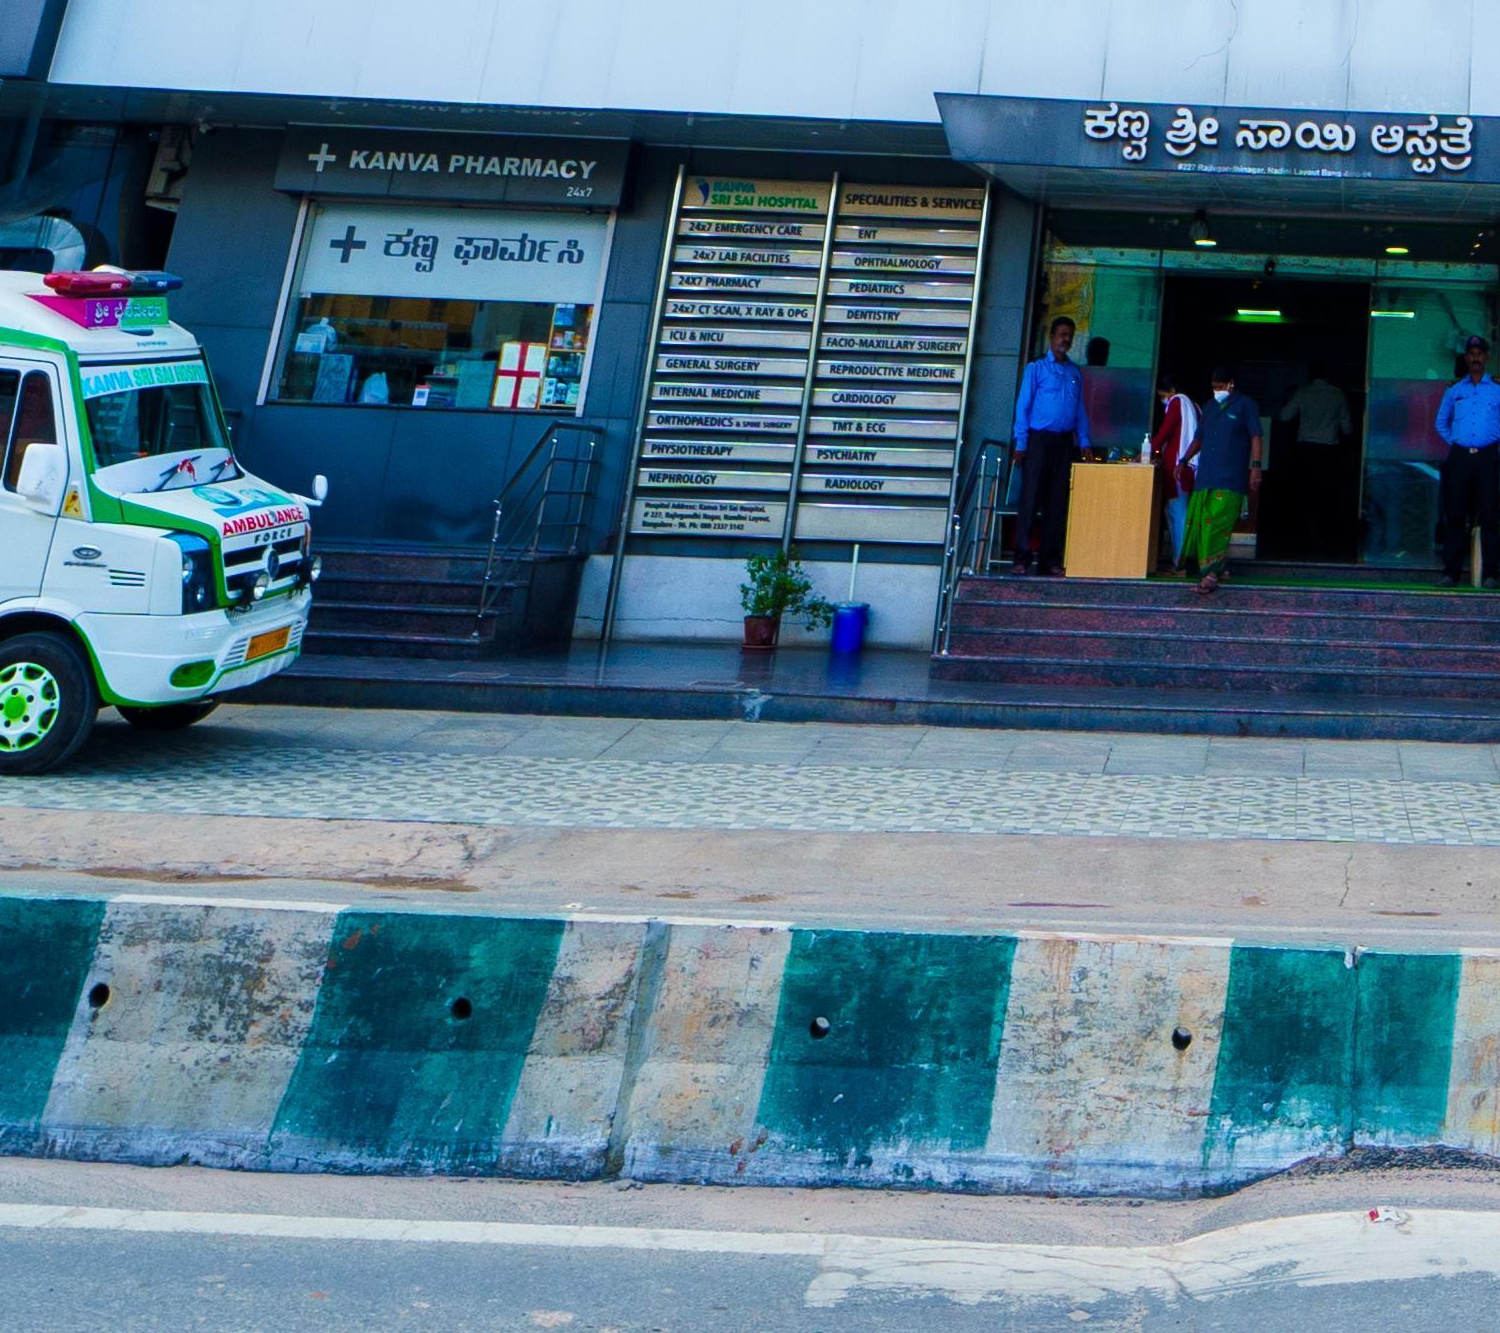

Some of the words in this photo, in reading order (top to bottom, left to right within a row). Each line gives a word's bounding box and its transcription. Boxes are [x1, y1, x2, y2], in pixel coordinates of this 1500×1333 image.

[1235, 117, 1356, 153] ಸಾಯಿ
[1370, 114, 1474, 174] ಆಸ್ಪತ್ರೆ
[349, 149, 440, 173] KANVA
[448, 154, 597, 180] PHARMACY
[566, 186, 593, 199] 24x7
[712, 181, 757, 194] KANVA
[711, 193, 731, 205] SRI
[733, 194, 754, 206] SAI
[757, 195, 819, 210] HOSPITAL
[845, 193, 918, 208] SPECIALITIES
[920, 196, 929, 207] &
[931, 197, 983, 210] SERVICES
[688, 221, 712, 232] 24x7
[714, 222, 775, 235] EMERGENCY
[776, 225, 803, 237] CARE
[857, 228, 878, 240] ENT
[692, 250, 717, 260] 24x7
[718, 251, 738, 262] LAB
[740, 252, 791, 263] FACILITIES
[854, 256, 941, 270] OPHTHALMOLOGY
[705, 277, 761, 289] PHARMACY
[848, 282, 905, 295] PEDIATRICS
[672, 303, 696, 314] 24x7
[698, 304, 713, 315] CT
[713, 305, 742, 317] SCAN,
[745, 307, 753, 316] X
[755, 307, 776, 317] RAY
[776, 308, 784, 318] &
[787, 308, 809, 319] OPG
[846, 309, 901, 322] DENTISTRY
[669, 330, 687, 341] ICU
[689, 331, 696, 341] &
[699, 332, 725, 343] NICU
[826, 337, 915, 351] FACIO-MAXILLARY
[917, 340, 963, 352] SURGERY
[666, 358, 711, 370] GENERAL
[714, 360, 760, 372] SURGERY
[829, 364, 904, 378] REPRODUCTIVE
[906, 367, 956, 379] MEDICINE
[83, 369, 134, 398] KANVA
[132, 366, 155, 387] SRI
[659, 386, 708, 398] INTERNAL
[711, 388, 761, 400] MEDICINE
[831, 392, 897, 405] CARDIOLOGY
[656, 414, 734, 428] ORTHOPAEDICS
[832, 421, 854, 432] TMT
[855, 422, 863, 432] &
[865, 422, 886, 433] ECG
[650, 443, 733, 457] PHYSIOTHERAPY
[816, 448, 878, 462] PSYCHIATRY
[647, 472, 718, 485] NEPHROLOGY
[824, 478, 885, 491] RADIOLOGY
[222, 507, 304, 537] AMBULANCE
[254, 528, 293, 544] FORCE
